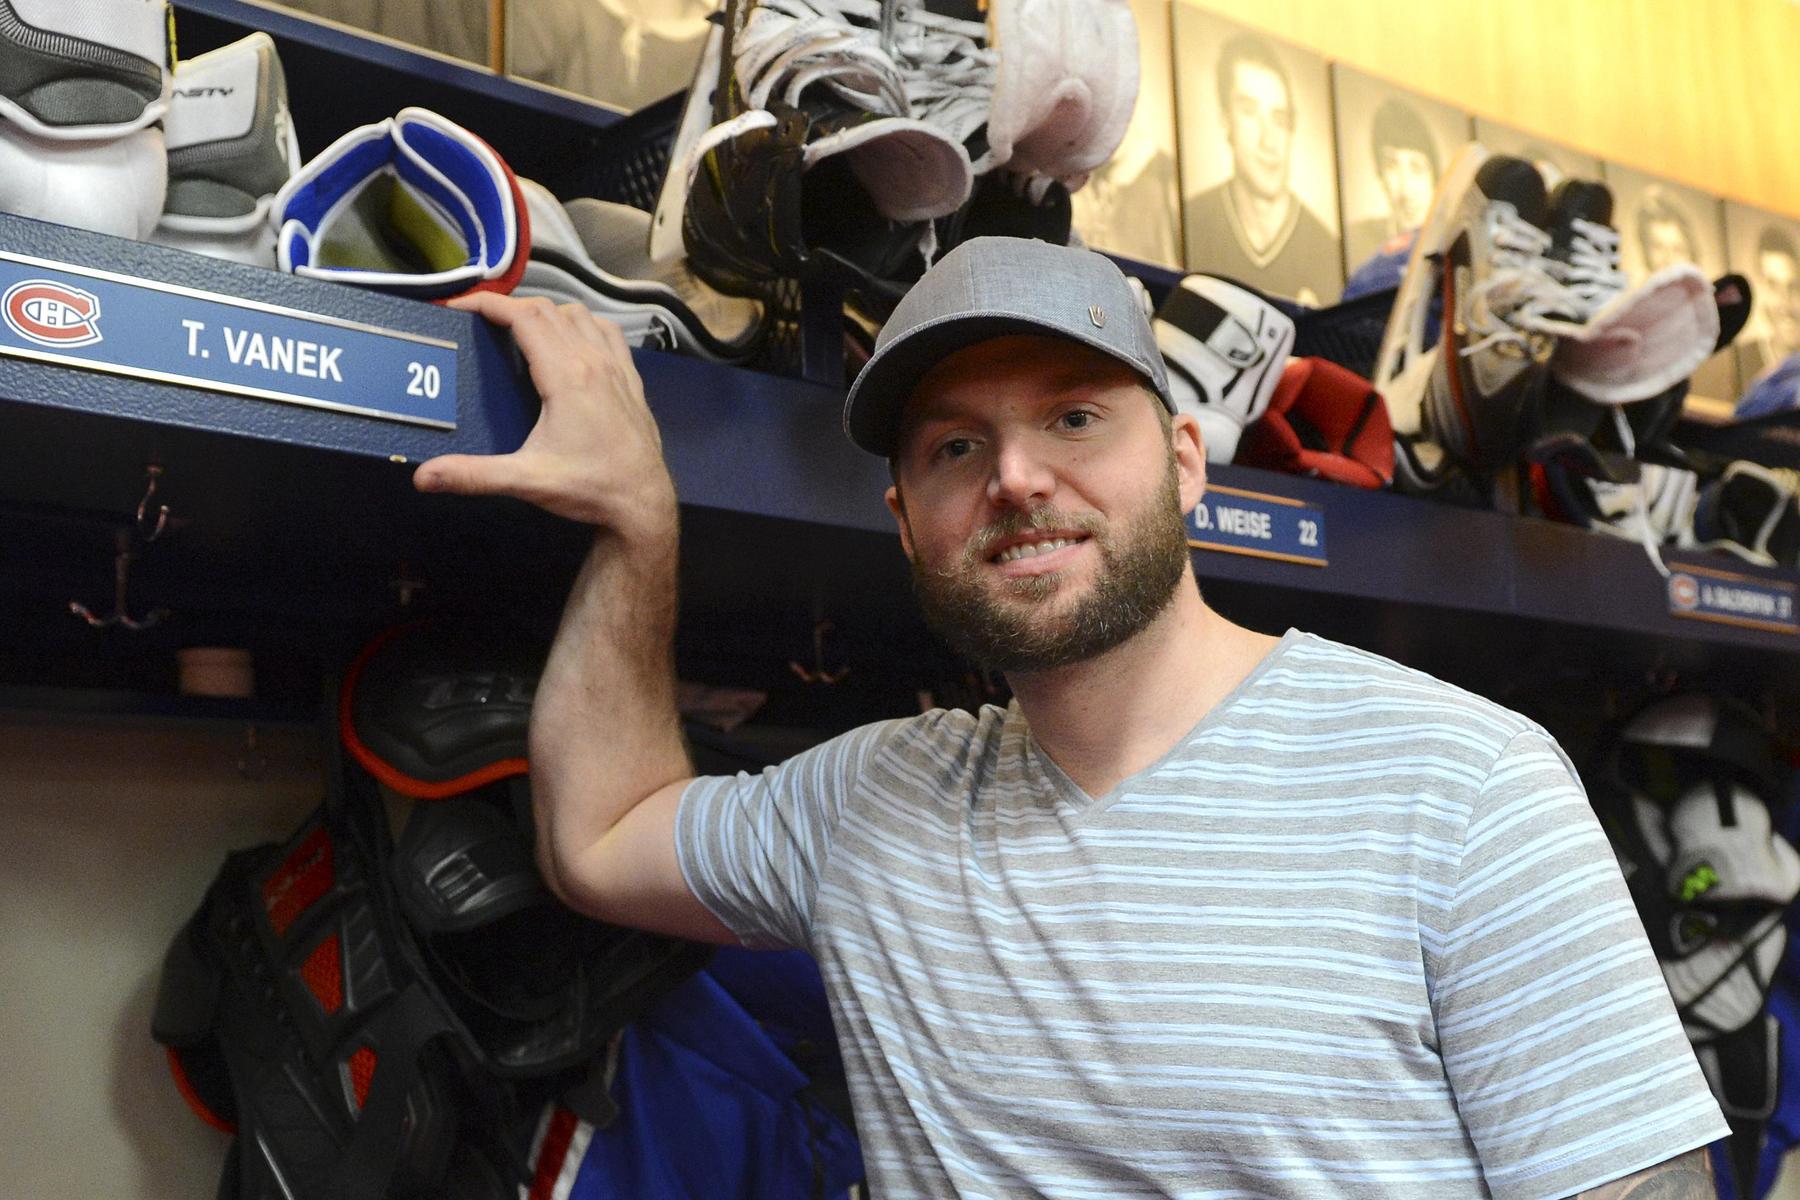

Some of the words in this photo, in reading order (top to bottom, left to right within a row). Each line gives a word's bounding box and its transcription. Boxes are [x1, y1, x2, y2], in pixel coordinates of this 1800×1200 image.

[182, 319, 209, 358] T.
[223, 326, 343, 382] VANEK
[406, 361, 440, 399] 20
[1215, 505, 1273, 539] WEISE
[1298, 519, 1318, 547] 22
